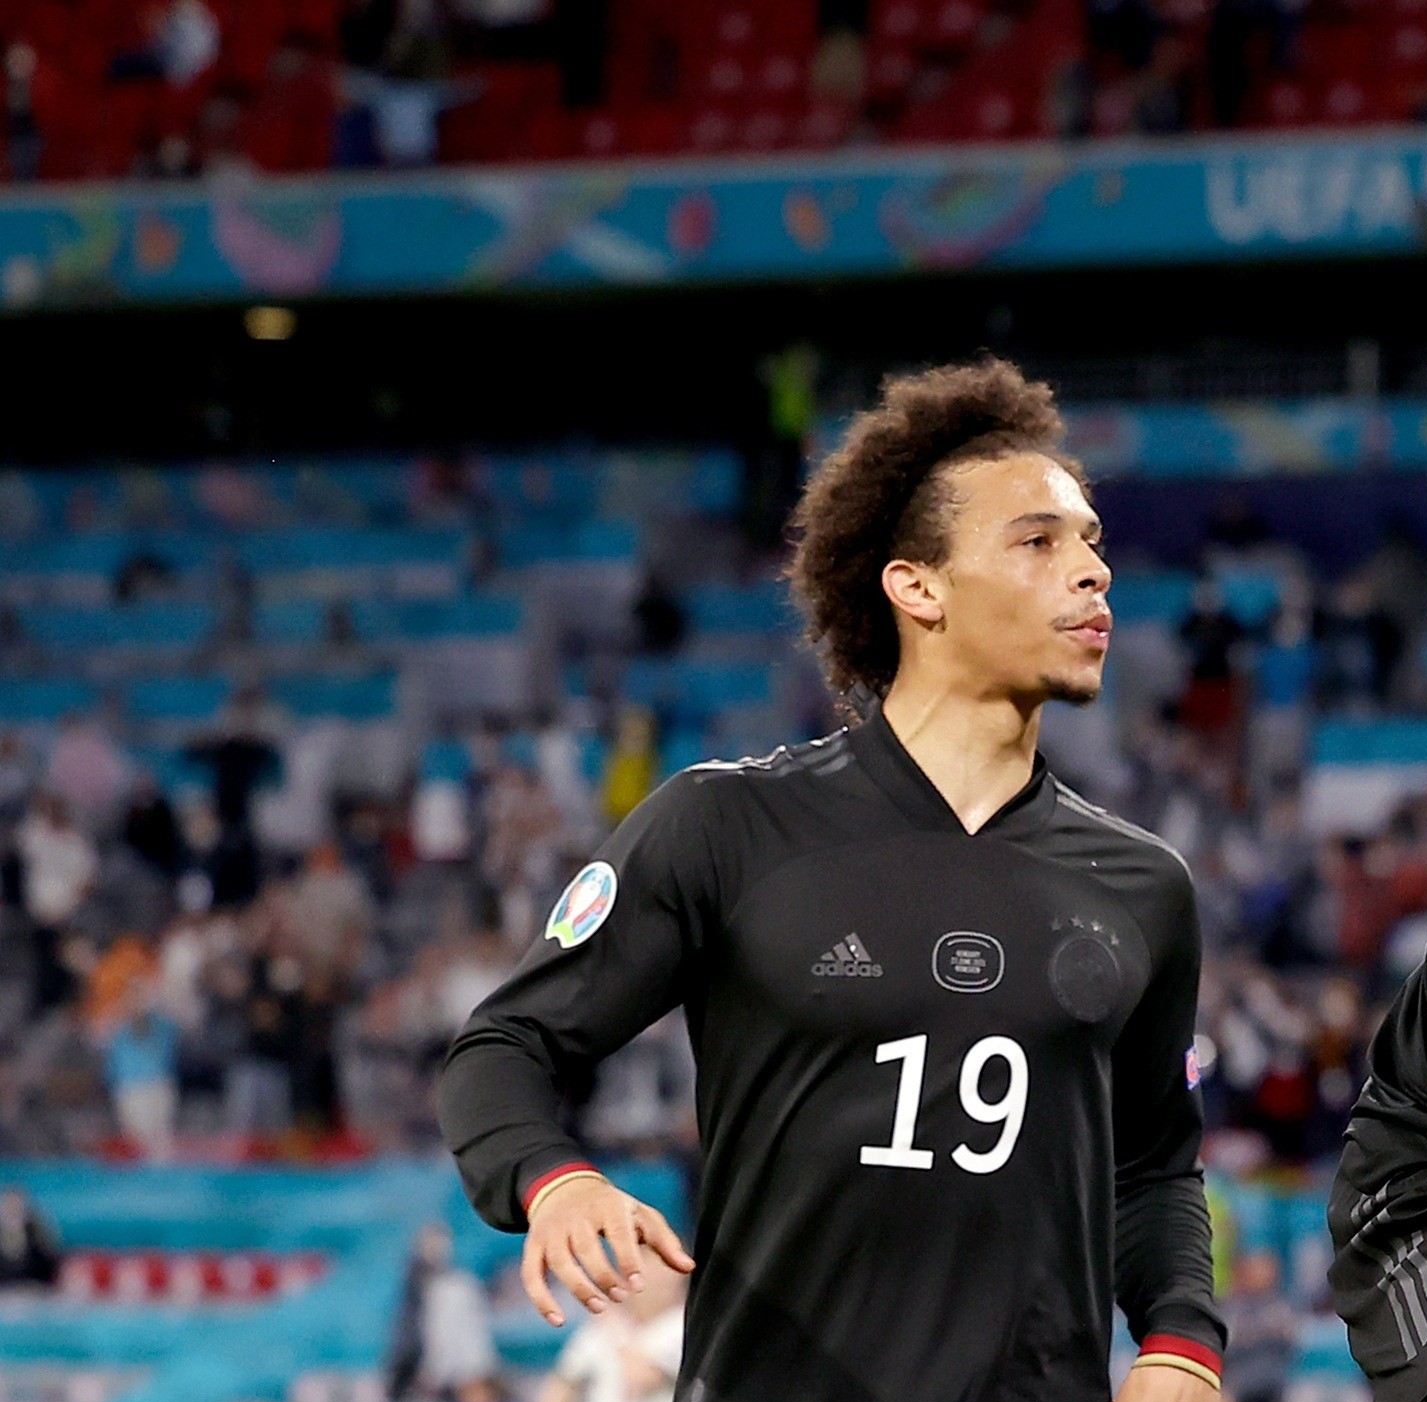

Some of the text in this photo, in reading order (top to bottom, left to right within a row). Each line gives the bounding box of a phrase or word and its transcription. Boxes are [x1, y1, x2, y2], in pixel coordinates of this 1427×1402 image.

[1205, 150, 1412, 244] UEFA
[810, 959, 884, 978] adidas
[860, 1033, 1029, 1174] 19
